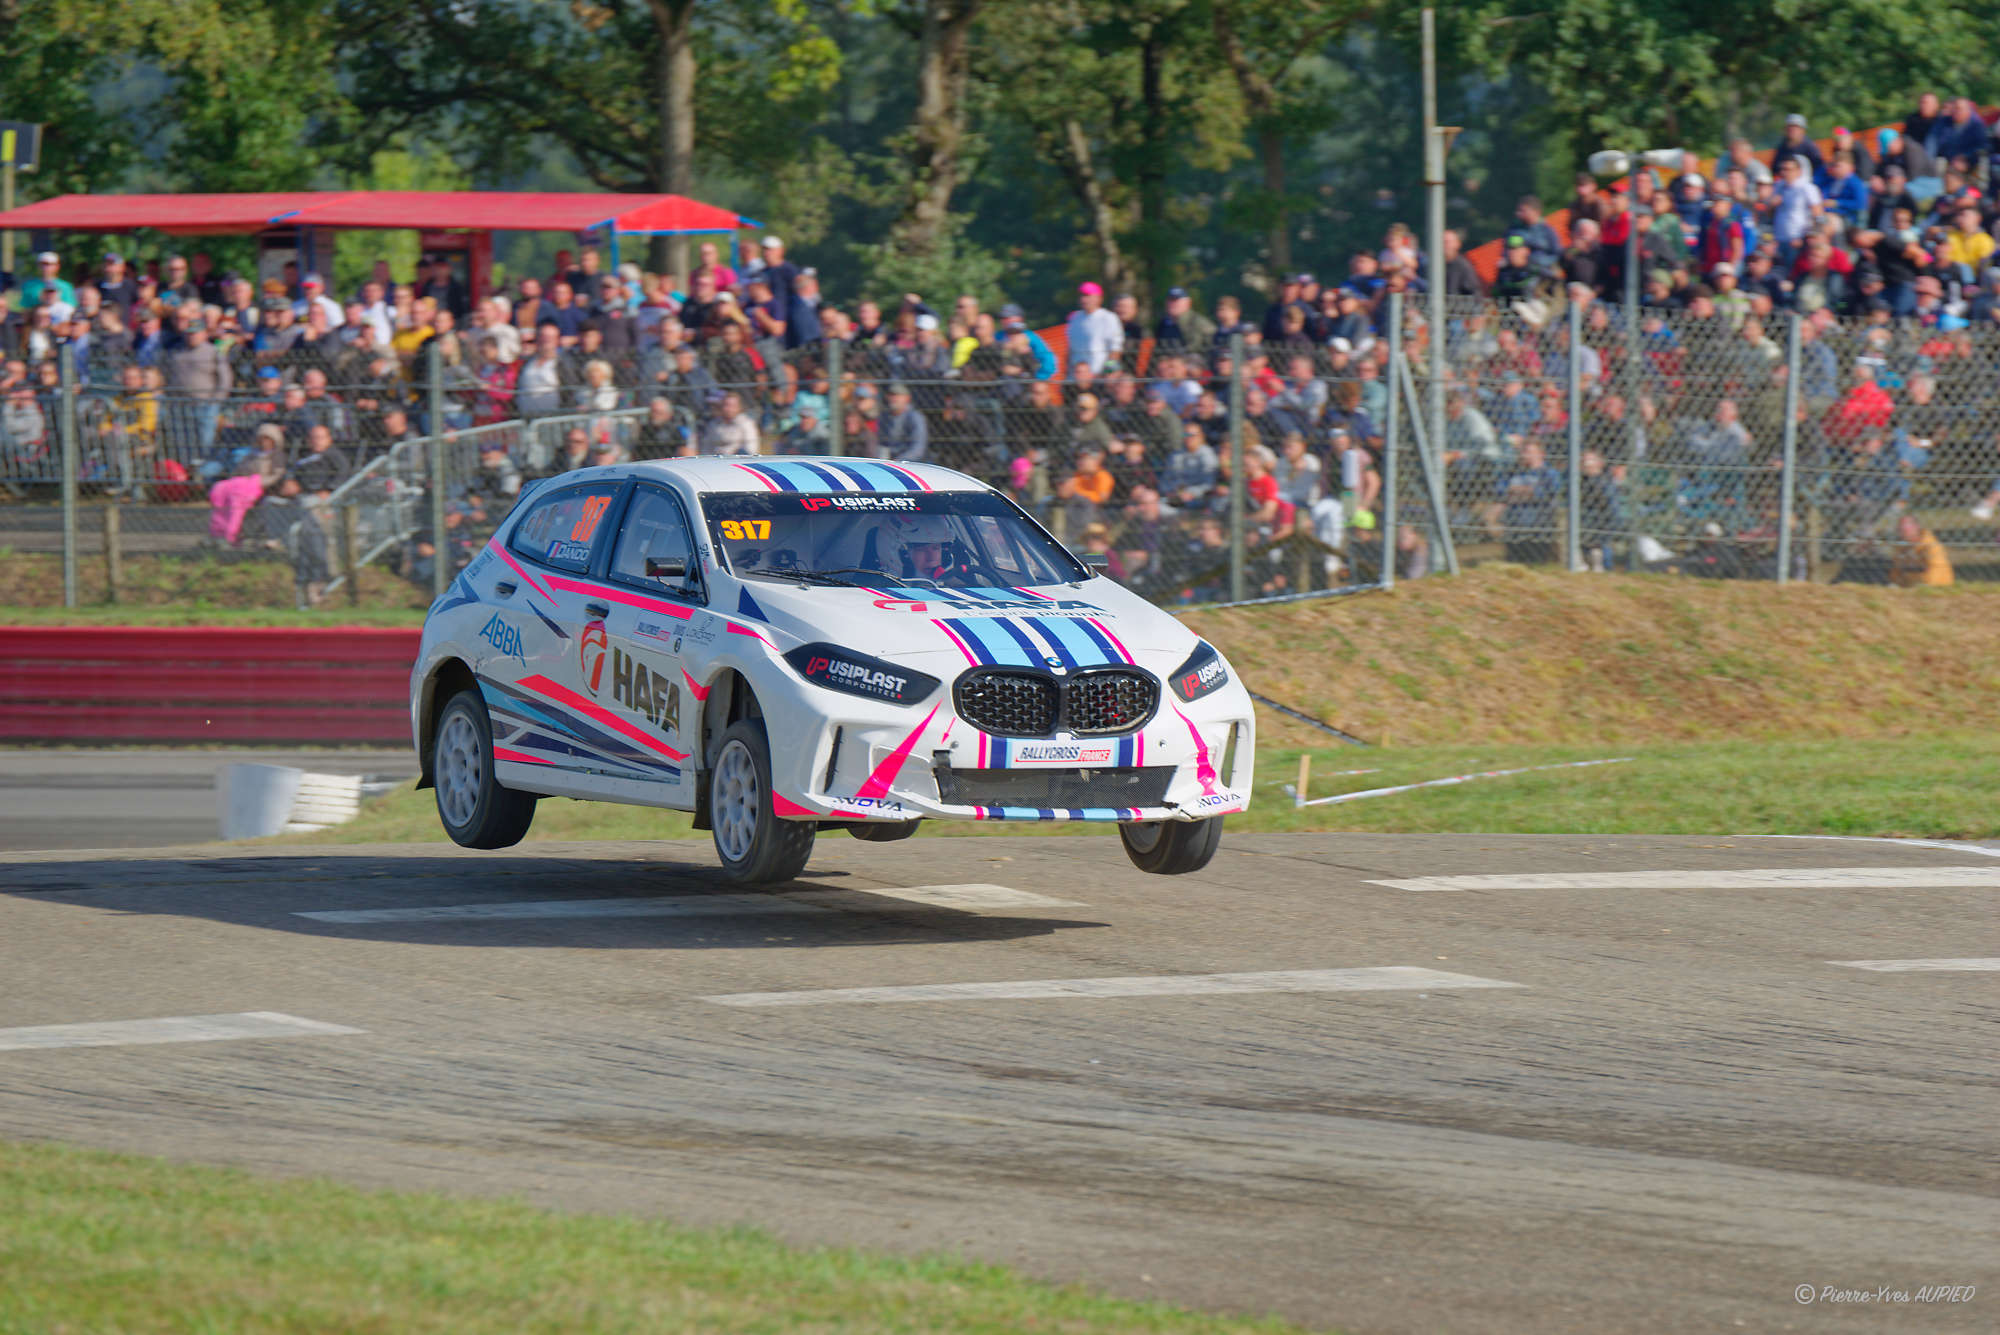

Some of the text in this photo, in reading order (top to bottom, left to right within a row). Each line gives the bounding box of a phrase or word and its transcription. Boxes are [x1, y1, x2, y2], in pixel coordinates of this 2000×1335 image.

[829, 497, 916, 507] USIPLAST
[571, 495, 612, 542] 317
[720, 519, 772, 540] 317
[479, 612, 526, 668] ABBA
[614, 646, 680, 733] HAFA
[828, 660, 907, 692] USIPLAST
[831, 675, 896, 698] COMPOSITES
[1020, 746, 1081, 760] RALLYCROSS
